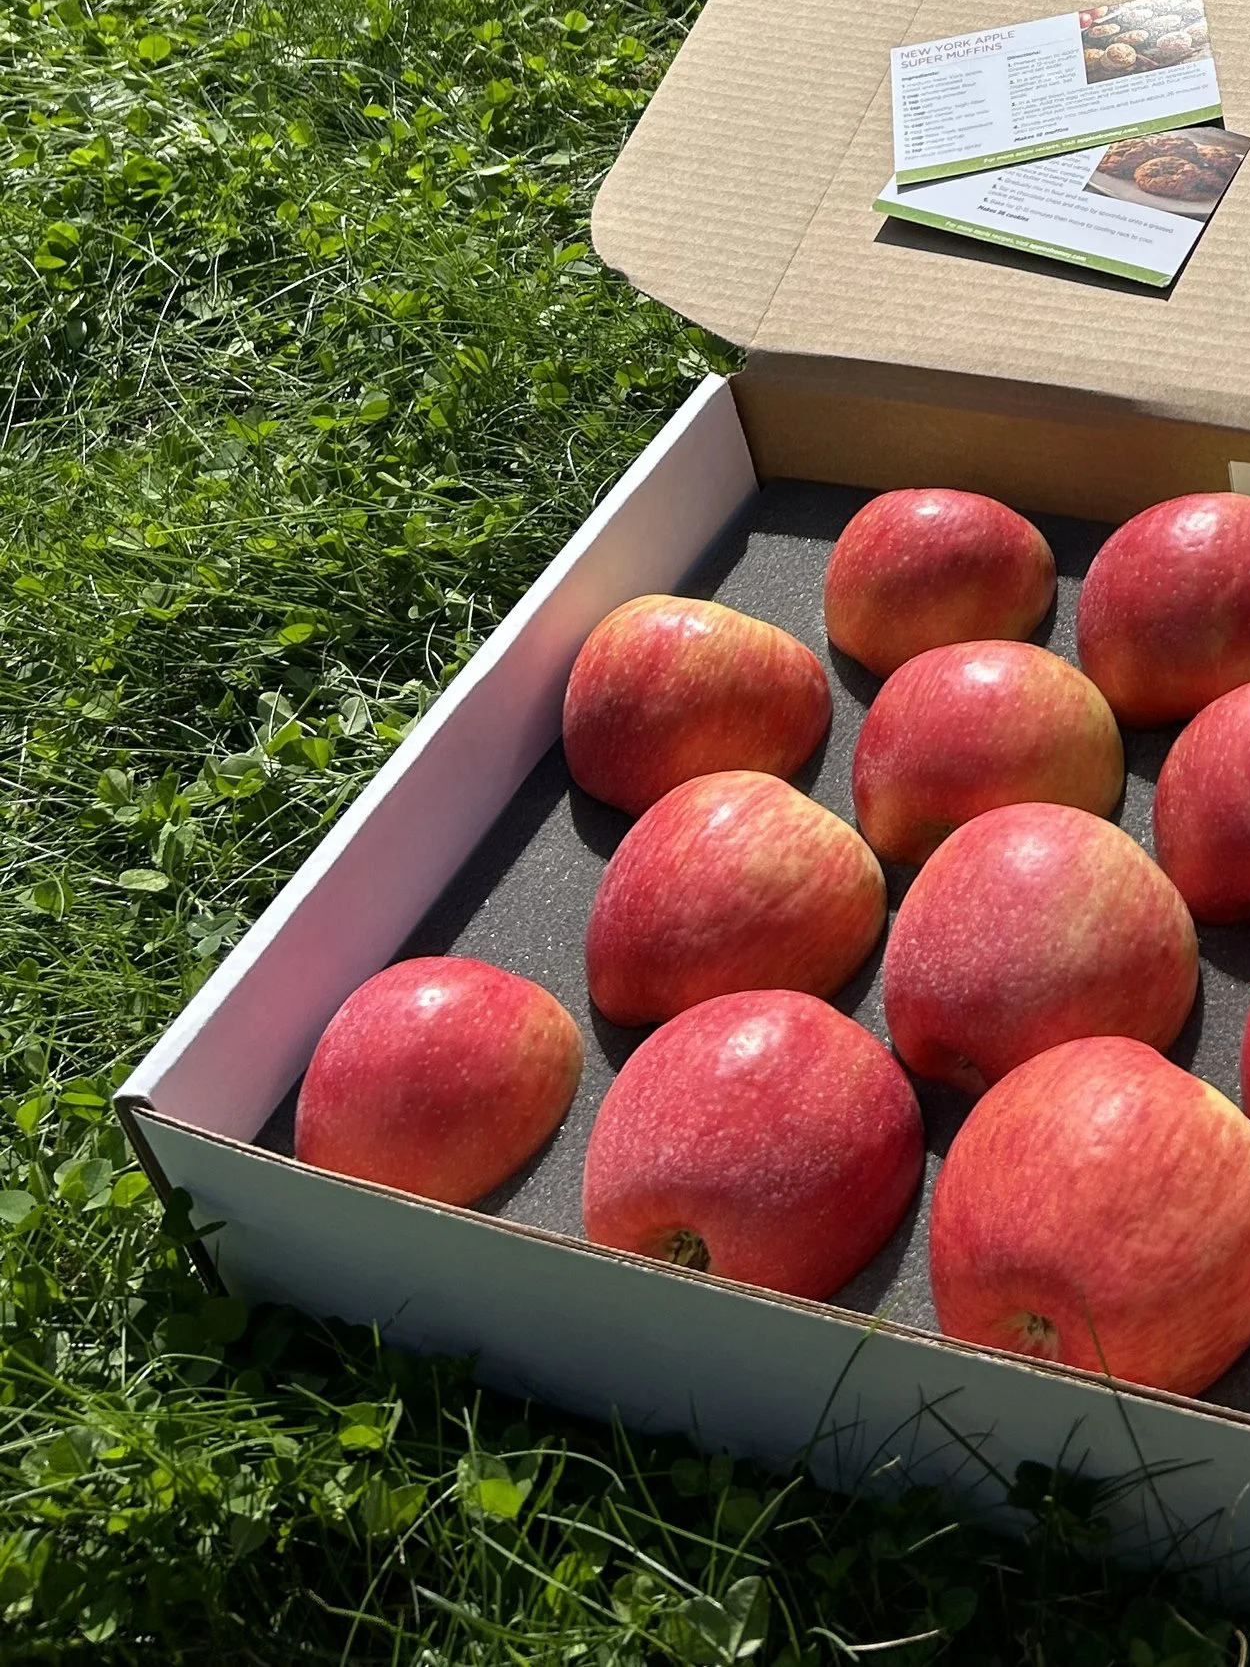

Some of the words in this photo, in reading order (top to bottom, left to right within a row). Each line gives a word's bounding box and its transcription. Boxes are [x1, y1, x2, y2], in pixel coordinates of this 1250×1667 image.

[900, 47, 931, 60] NEW
[936, 40, 971, 53] YORK
[975, 30, 1016, 45] APPLE
[900, 54, 943, 69] SUPER
[946, 42, 1003, 59] MUFFINS
